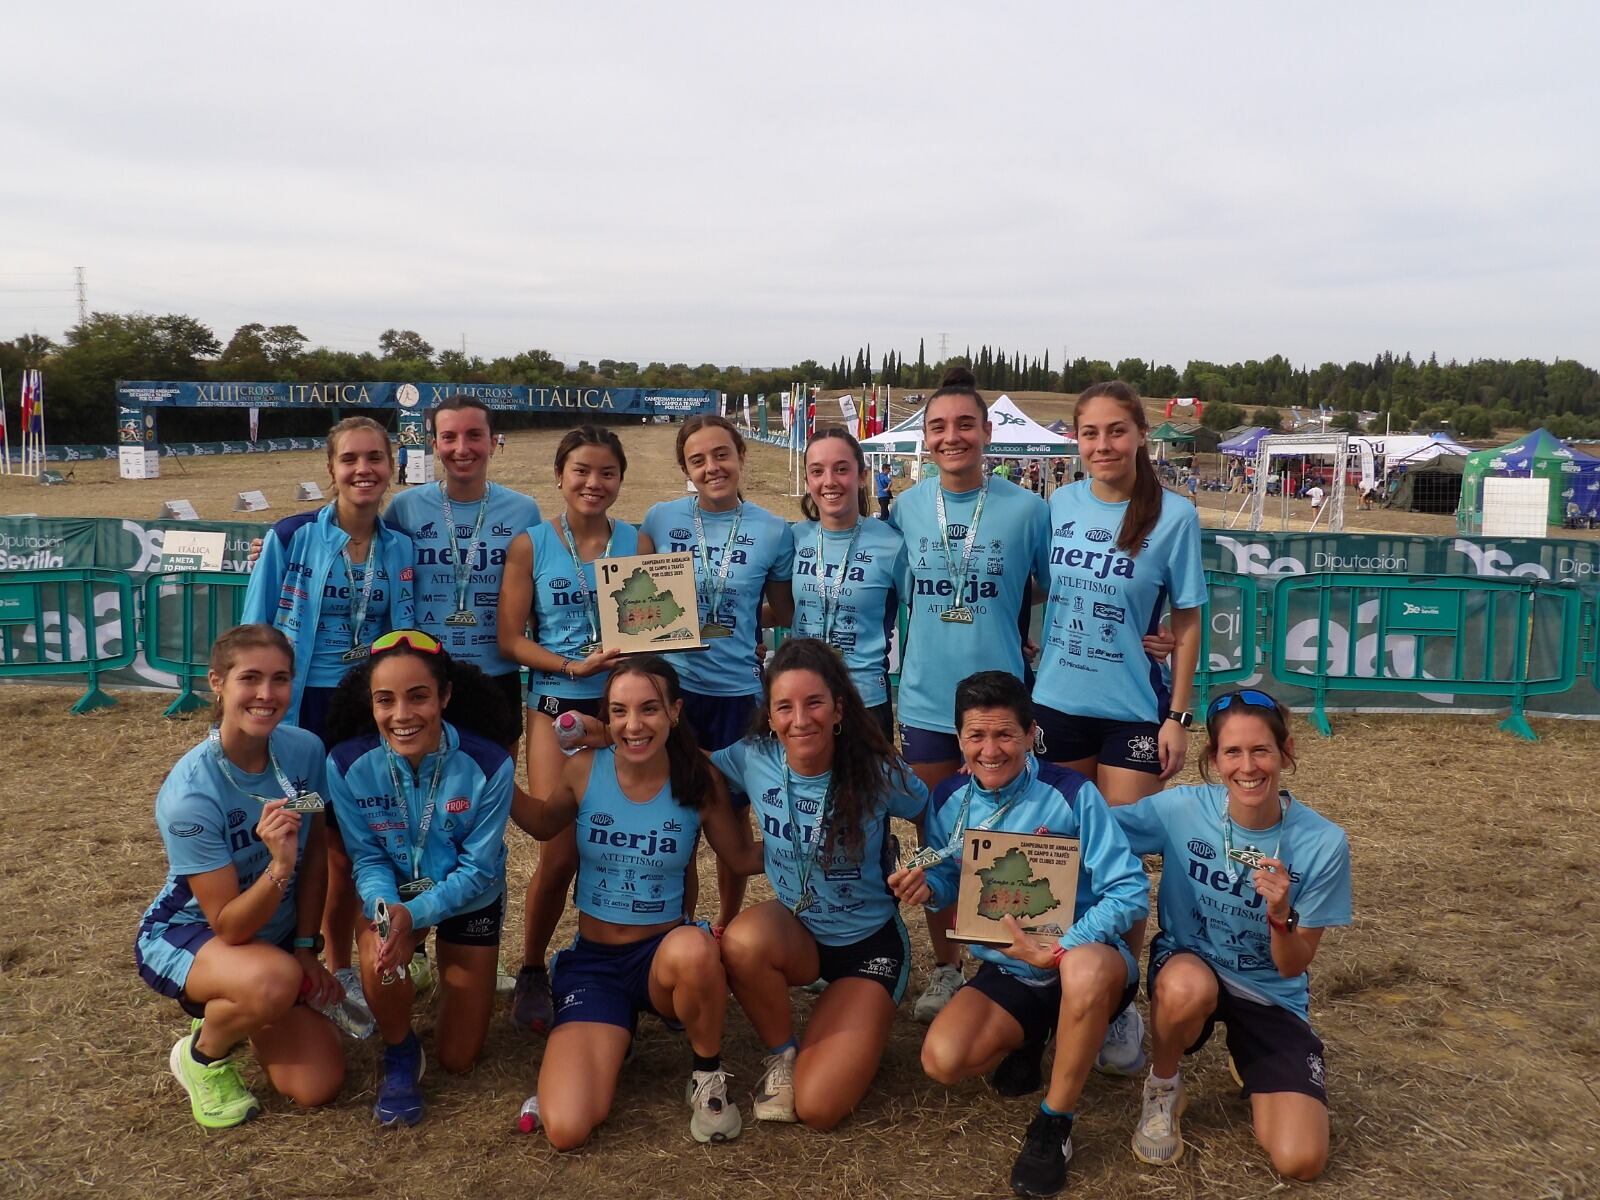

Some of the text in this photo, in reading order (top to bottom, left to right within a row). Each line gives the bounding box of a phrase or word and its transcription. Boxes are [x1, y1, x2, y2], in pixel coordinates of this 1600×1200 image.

[196, 386, 274, 401] XLIII CROSS
[289, 382, 370, 403] ITÁLICA
[476, 388, 512, 398] CROSS
[528, 385, 614, 409] ITÁLICA
[1027, 444, 1051, 452] Sevilla
[491, 523, 513, 536] als
[670, 529, 692, 539] TROPS
[1086, 530, 1112, 541] TROPS
[737, 533, 754, 545] als
[176, 556, 194, 564] META
[854, 550, 873, 562] als
[1050, 546, 1135, 579] nerja
[1314, 551, 1408, 571] Diputación
[602, 564, 618, 584] 1º
[358, 794, 398, 811] nerja
[446, 799, 470, 812] TROPS
[591, 814, 613, 825] TROPS
[663, 818, 682, 831] als
[587, 827, 677, 856] nerja
[1021, 841, 1048, 850] CAMPEONATO
[1056, 844, 1078, 852] ANDALUCÍA
[971, 838, 992, 860] 1º
[1054, 850, 1070, 858] TRAVÉS
[1187, 840, 1216, 859] TROPS
[601, 852, 664, 868] ATLETISMO
